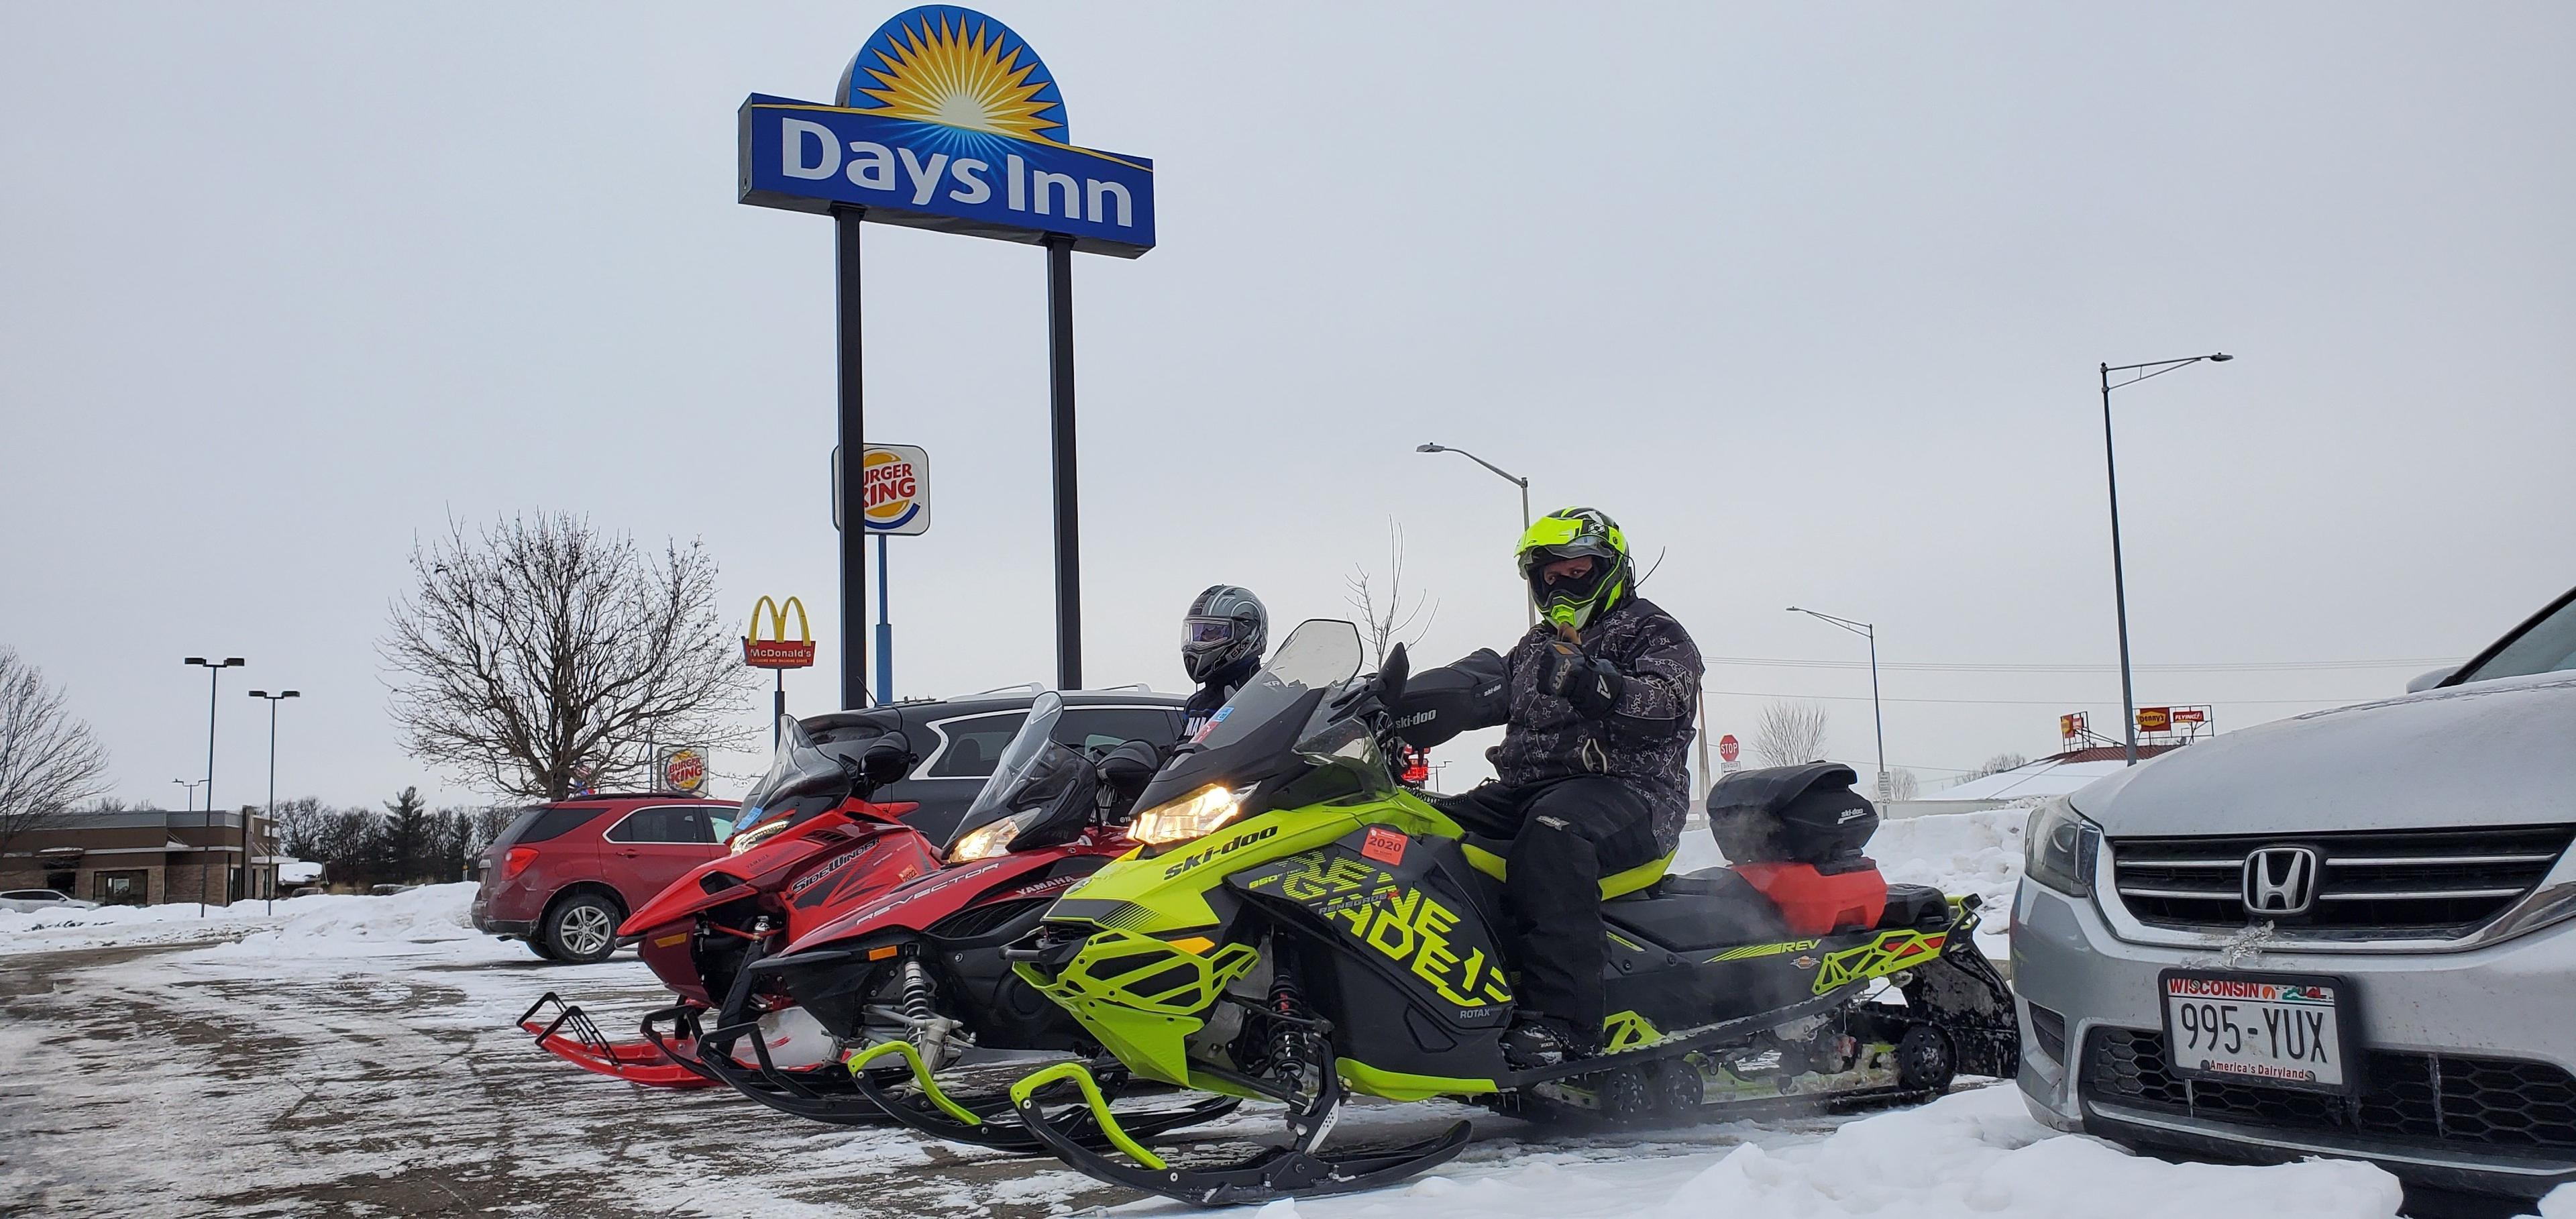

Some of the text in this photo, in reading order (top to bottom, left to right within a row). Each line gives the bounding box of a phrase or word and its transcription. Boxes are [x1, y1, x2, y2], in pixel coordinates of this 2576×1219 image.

[782, 117, 1132, 227] Days Inn
[863, 463, 912, 486] URGER
[750, 649, 811, 657] McDonald's
[1395, 709, 1437, 729] ski-doo
[2139, 714, 2165, 723] Denny's
[1721, 743, 1737, 754] STOP
[669, 757, 701, 774] BURGER
[669, 765, 702, 784] KING
[1164, 825, 1278, 881] ski-doo
[1368, 837, 1402, 853] 2020
[1016, 875, 1074, 897] YAMAHA
[1781, 939, 1822, 953] REV
[2169, 978, 2259, 998] WISCONSIN
[1460, 1008, 1491, 1019] ROTAX
[2181, 1003, 2328, 1063] 995-YUX
[2210, 1059, 2304, 1079] America's Dairyland
